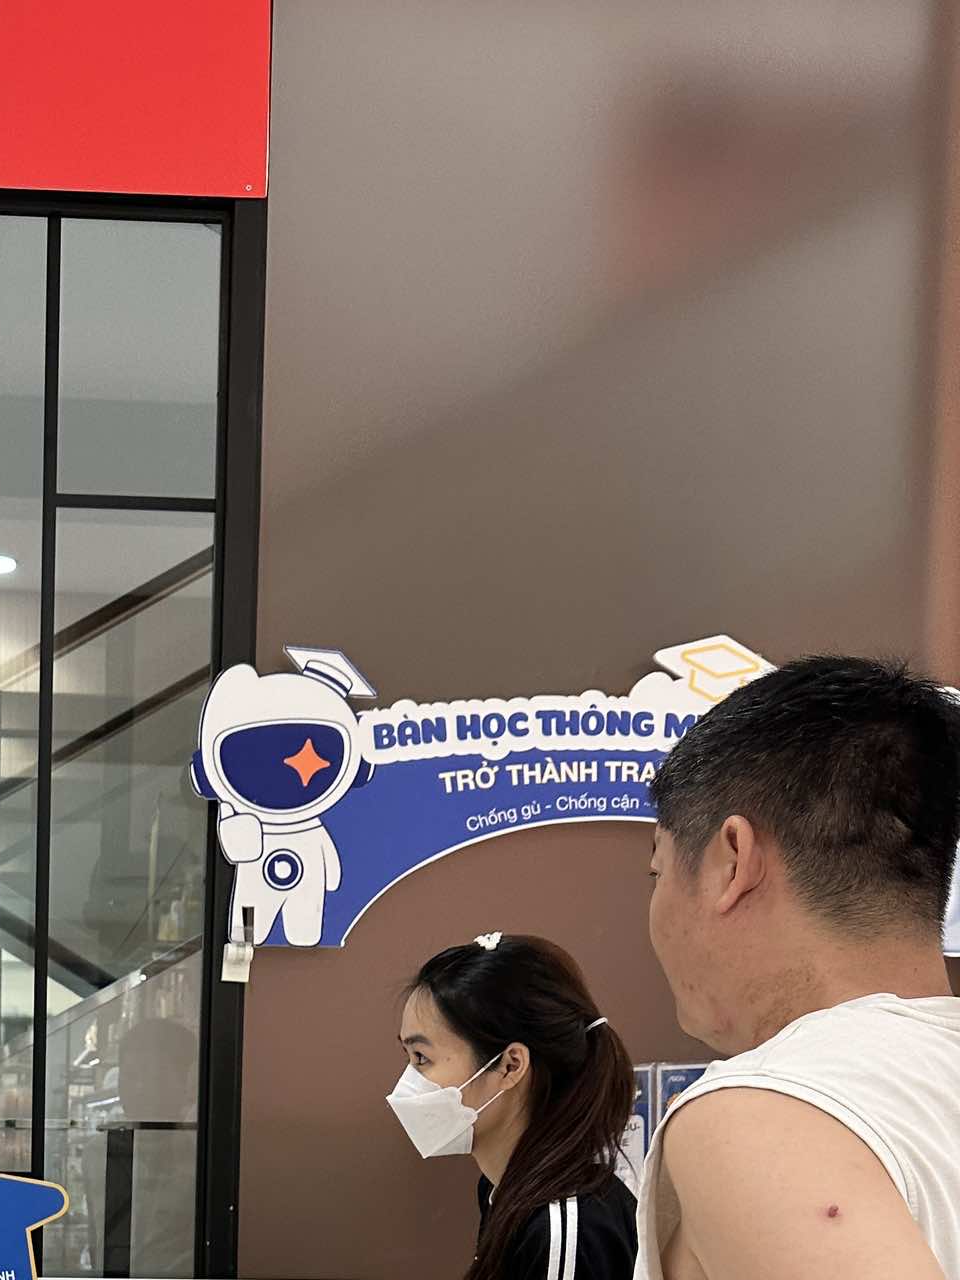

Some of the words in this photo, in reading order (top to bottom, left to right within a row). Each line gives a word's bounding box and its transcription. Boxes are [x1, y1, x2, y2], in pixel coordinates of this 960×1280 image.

[373, 713, 447, 750] BÀN
[456, 711, 529, 747] HỌC
[535, 704, 655, 738] THÔNG
[663, 712, 708, 739] M
[439, 760, 500, 794] TRỞ
[505, 757, 598, 787] THÀNH
[604, 760, 657, 787] TRẠ
[465, 808, 517, 833] Chống
[555, 791, 607, 812] Chống
[610, 793, 640, 814] cận
